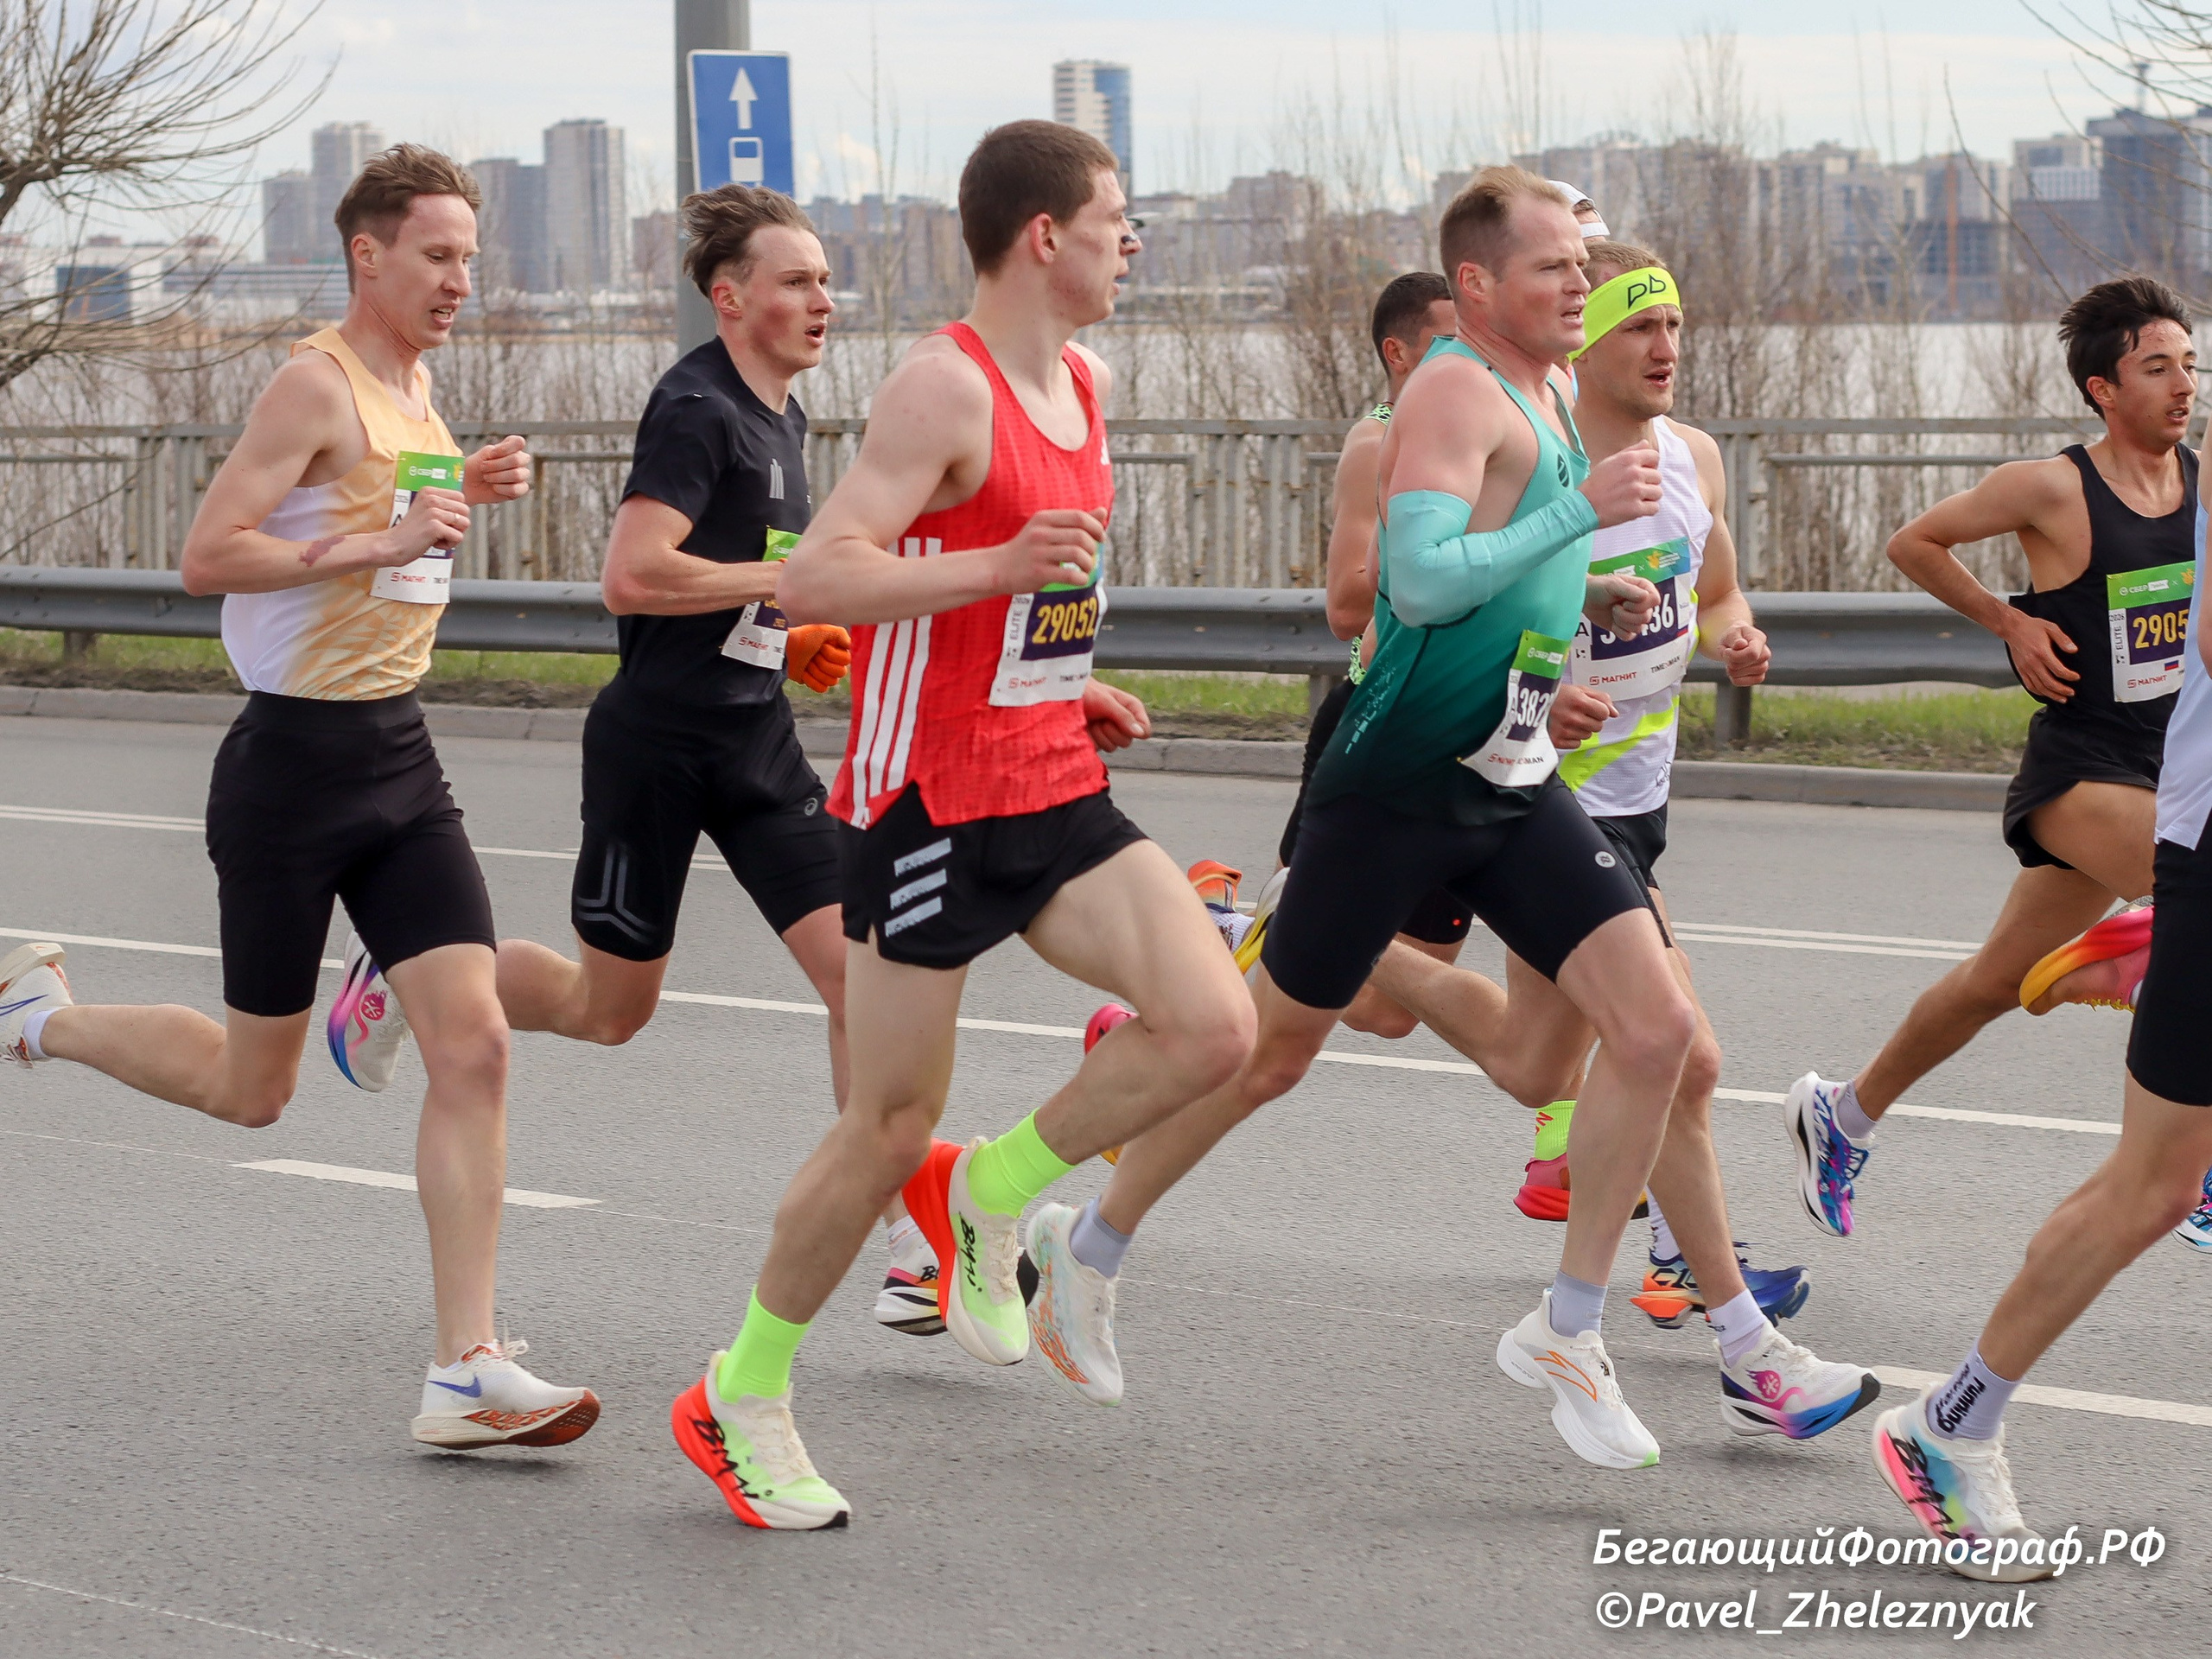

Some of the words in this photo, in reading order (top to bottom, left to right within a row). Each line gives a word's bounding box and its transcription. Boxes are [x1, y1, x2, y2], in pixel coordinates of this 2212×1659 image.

[1031, 596, 1097, 645] 29052
[2113, 626, 2124, 651] ELITE
[1601, 671, 1637, 683] МАГНИТ
[1936, 1376, 1986, 1433] running
